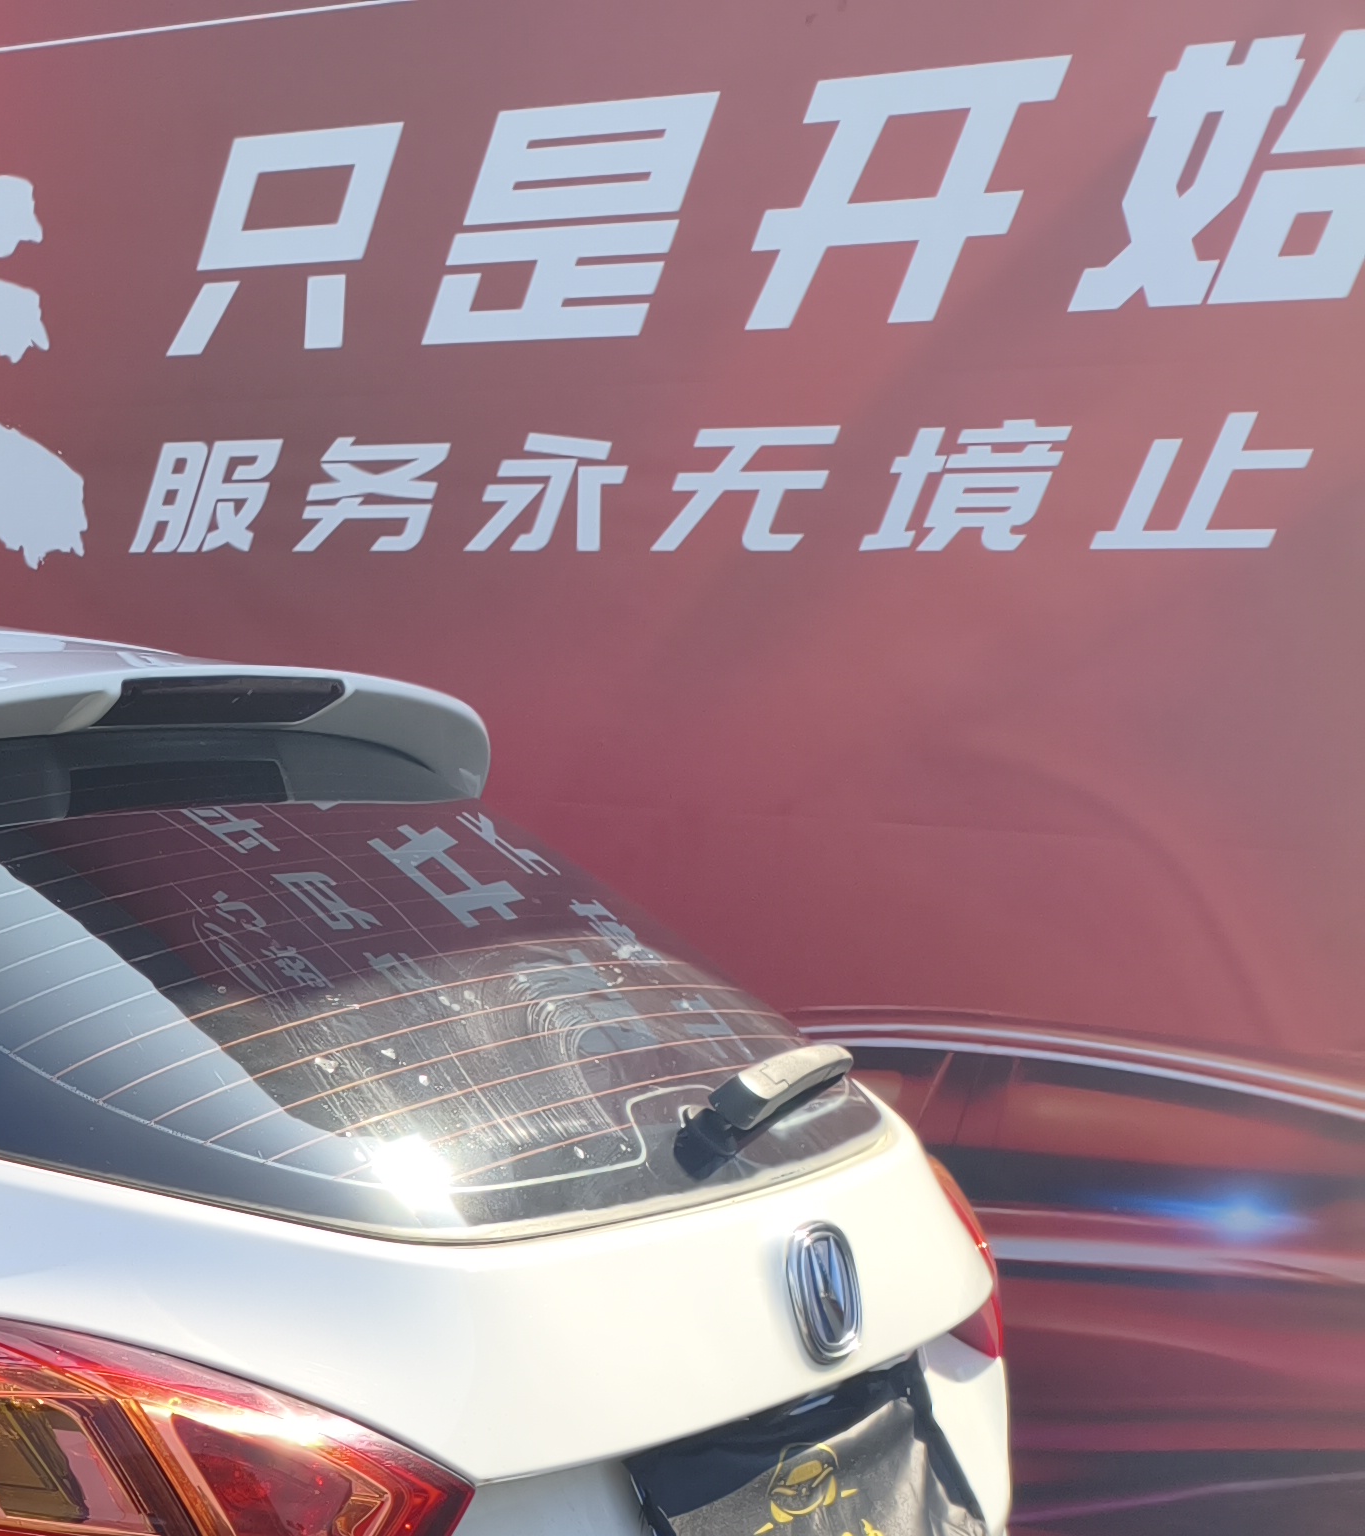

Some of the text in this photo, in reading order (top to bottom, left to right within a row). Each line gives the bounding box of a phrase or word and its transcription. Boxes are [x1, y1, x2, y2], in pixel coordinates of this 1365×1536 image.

[166, 29, 1365, 357] 只是开始
[129, 411, 1314, 554] 服务永无境止
